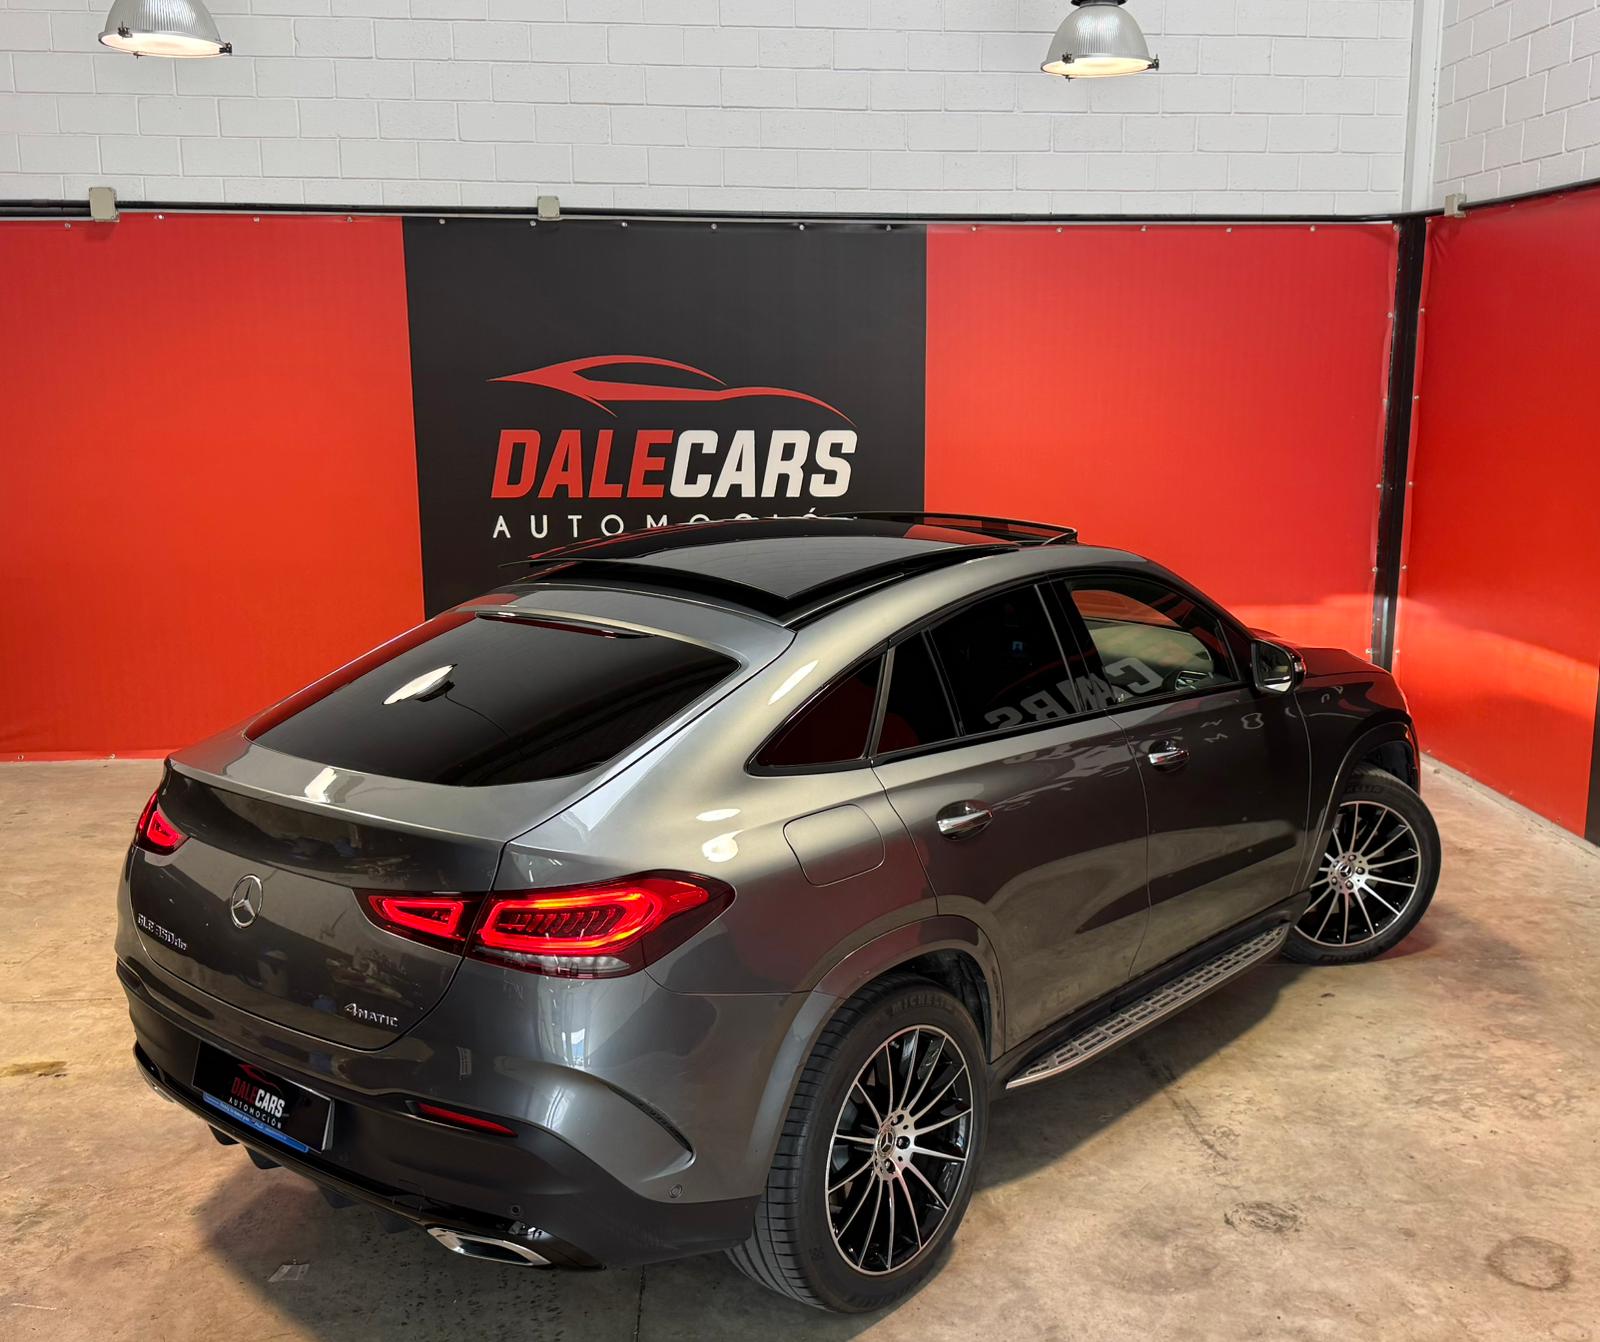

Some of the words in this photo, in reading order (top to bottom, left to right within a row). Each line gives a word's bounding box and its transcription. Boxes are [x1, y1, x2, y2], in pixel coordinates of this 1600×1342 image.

[490, 429, 858, 499] DALECARS
[344, 1002, 399, 1028] 4MATIC
[228, 1096, 283, 1130] AUTOMOCIÓN
[231, 1076, 286, 1119] DALECARS
